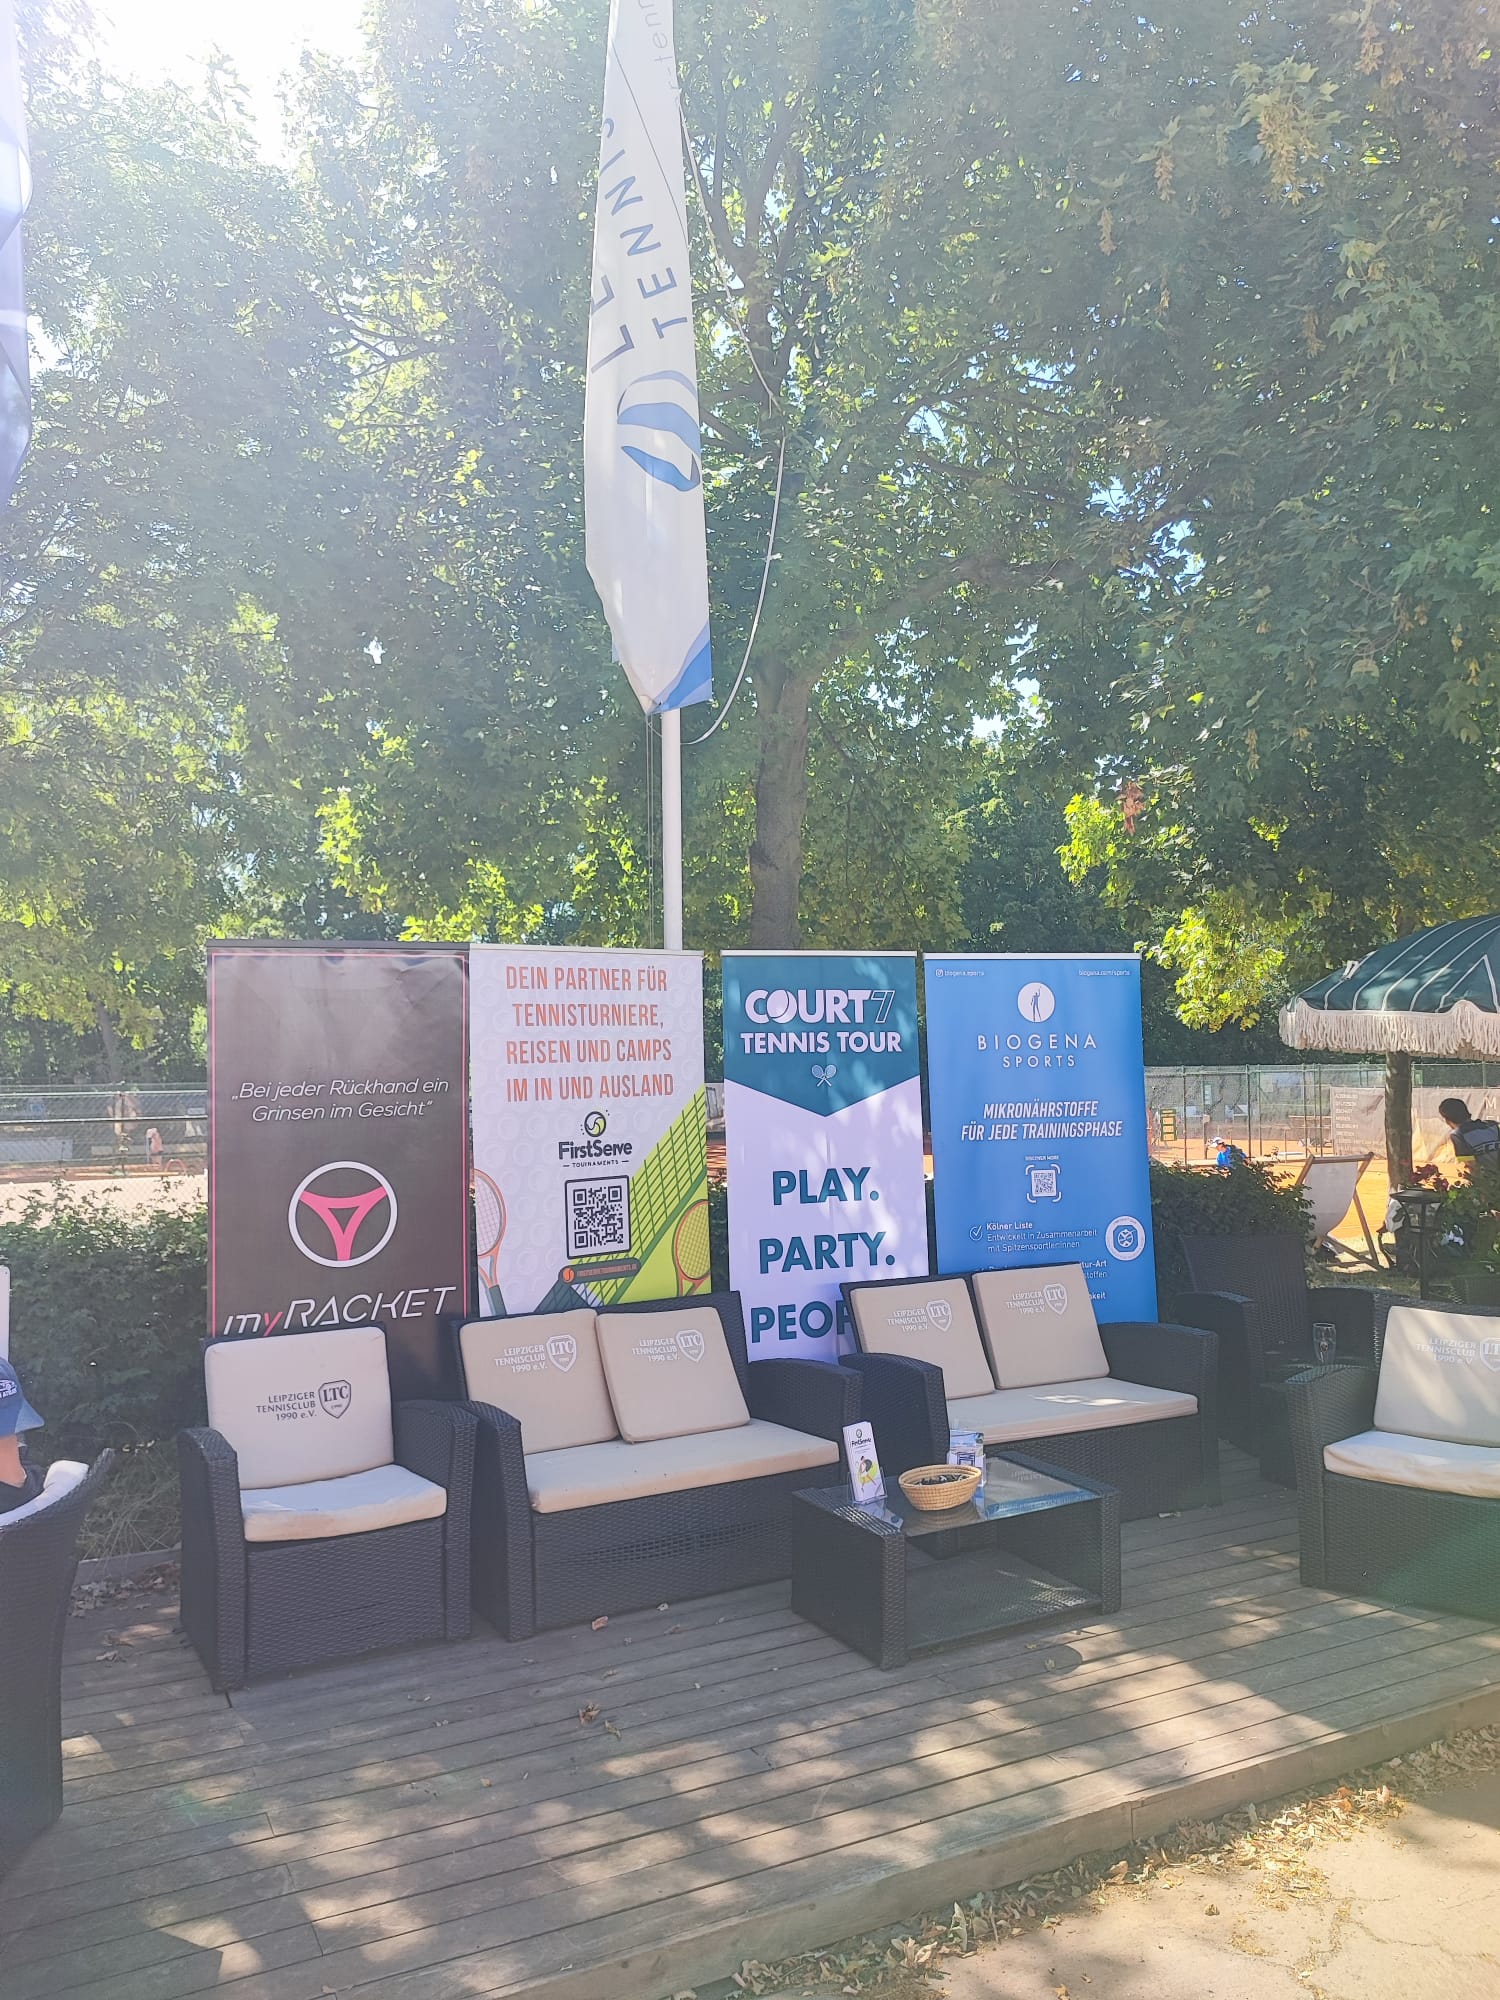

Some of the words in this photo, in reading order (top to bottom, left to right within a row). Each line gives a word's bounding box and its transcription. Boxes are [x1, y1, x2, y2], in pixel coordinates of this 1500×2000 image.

[506, 966, 548, 990] DEIN
[554, 967, 632, 991] PARTNER
[637, 965, 667, 991] FÜR
[512, 1003, 664, 1029] TENNISTURNIERE,
[741, 1031, 831, 1055] TENNIS
[838, 1030, 902, 1054] TOUR
[977, 1033, 1097, 1051] BIOGENA
[506, 1040, 571, 1064] REISEN
[577, 1039, 611, 1063] UND
[616, 1039, 672, 1062] CAMPS
[1002, 1055, 1076, 1068] SPORTS
[271, 1081, 325, 1101] jeder
[329, 1078, 420, 1096] Rückhand
[422, 1077, 449, 1093] ein
[506, 1078, 528, 1102] IM
[535, 1077, 552, 1101] IN
[559, 1076, 593, 1100] UND
[600, 1074, 674, 1098] AUSLAND
[252, 1105, 325, 1122] Grinsen
[329, 1103, 352, 1119] im
[983, 1098, 1099, 1120] MIKRONÄHRSTOFFE
[961, 1121, 985, 1141] FÜR
[988, 1123, 1018, 1141] JEDE
[1022, 1120, 1123, 1140] TRAININGSPHASE
[558, 1140, 633, 1160] FirstServe
[772, 1166, 880, 1206] PLAY.
[986, 1221, 1012, 1231] Kölner
[1014, 1221, 1033, 1230] Liste
[987, 1233, 1026, 1243] Entwickelt
[1028, 1232, 1035, 1240] in
[1036, 1229, 1097, 1240] Zusammenarbeit
[759, 1231, 896, 1274] PARTY.
[988, 1244, 1000, 1253] mit
[224, 1287, 456, 1336] myRACKET
[503, 1344, 545, 1357] LEIPZIGER
[550, 1340, 575, 1356] LTC
[494, 1353, 546, 1367] TENNISCLUB
[511, 1363, 531, 1373] 1990
[268, 1391, 315, 1404] LEIPZIGER
[322, 1385, 349, 1403] LTC
[256, 1400, 316, 1414] TENNISCLUB
[276, 1411, 298, 1421] 1990
